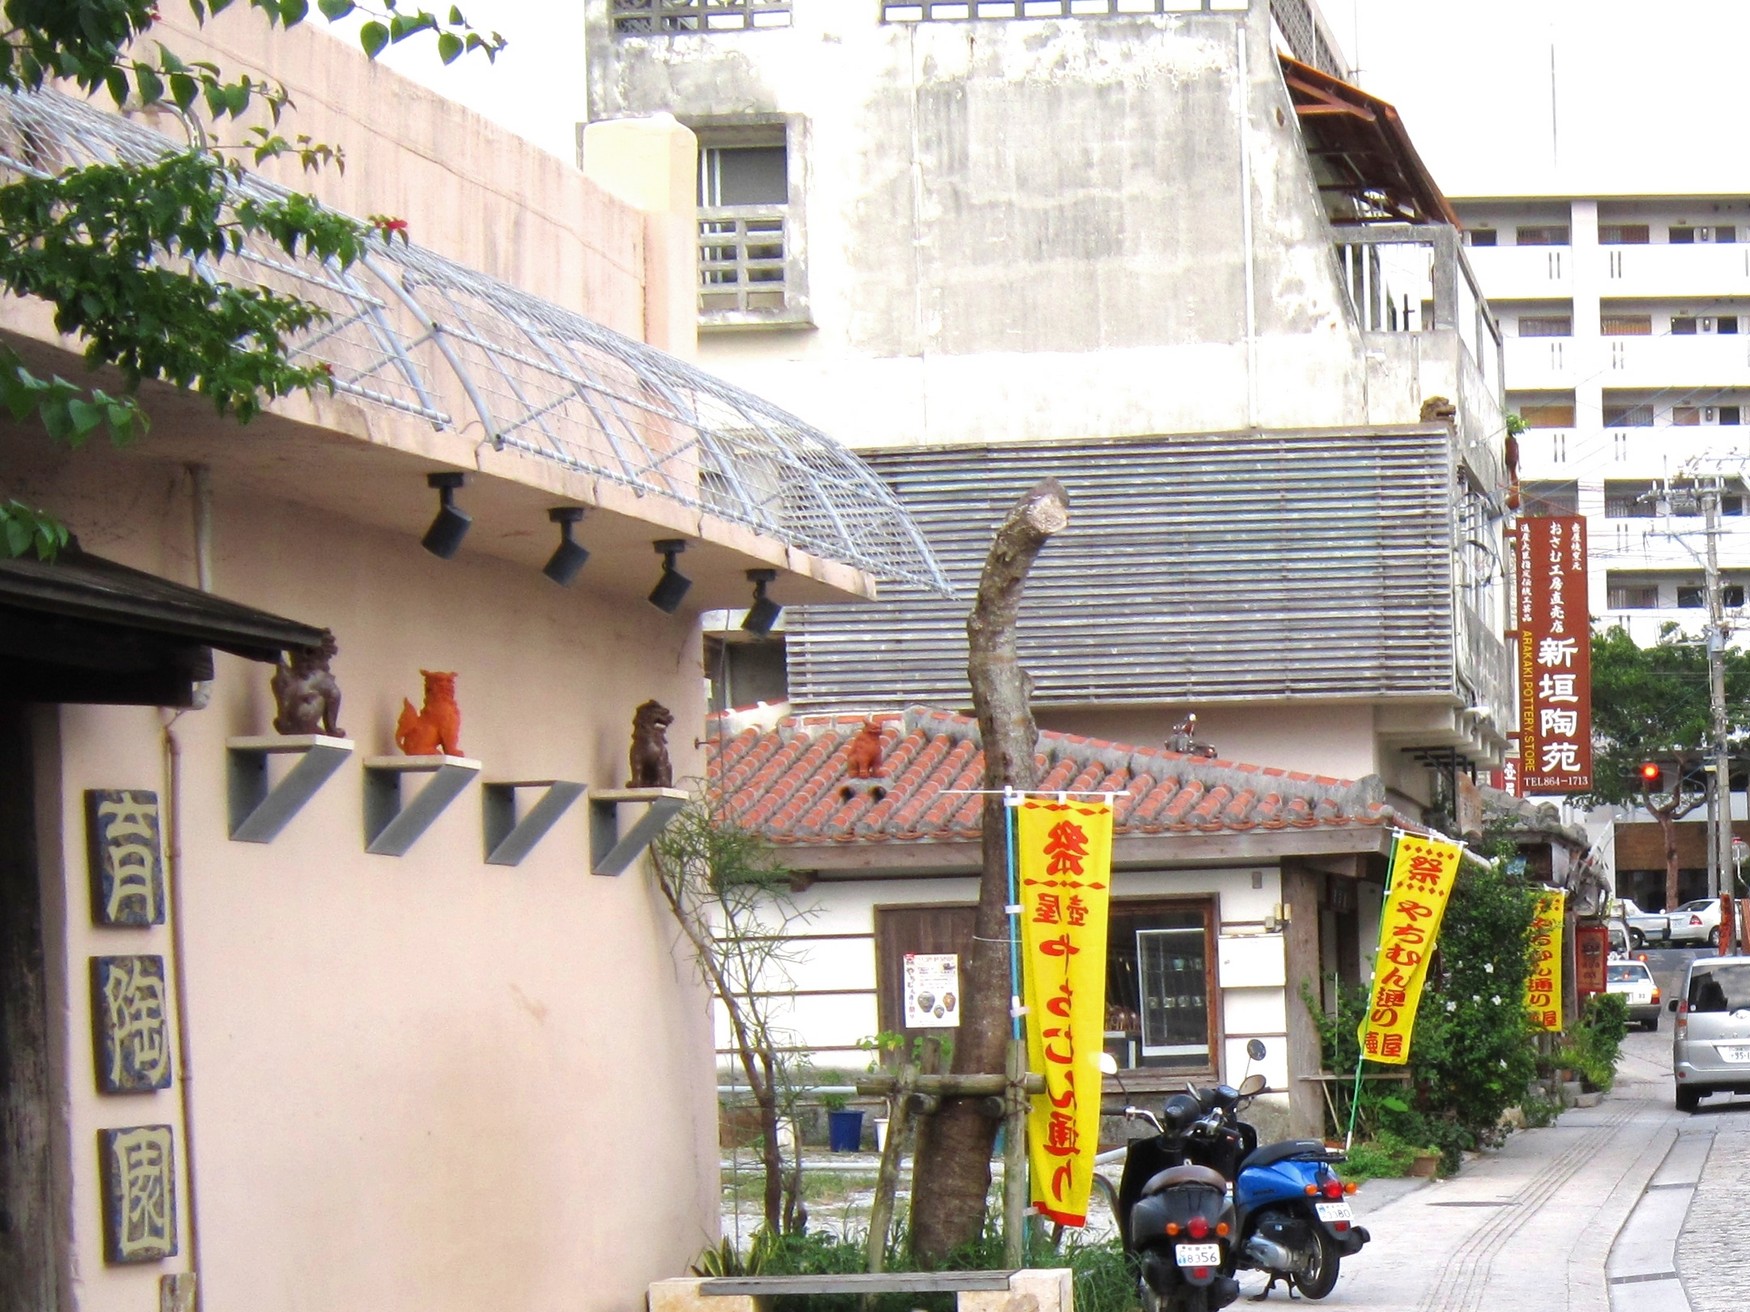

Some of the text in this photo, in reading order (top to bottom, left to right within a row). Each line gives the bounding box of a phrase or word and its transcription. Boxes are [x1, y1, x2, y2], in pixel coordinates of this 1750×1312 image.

[1549, 521, 1564, 633] おさむ工房直売店
[1537, 637, 1581, 773] 新垣陶苑
[1408, 856, 1443, 886] 祭
[98, 791, 172, 1256] 育陶園
[1370, 899, 1433, 1028] やちむん通り
